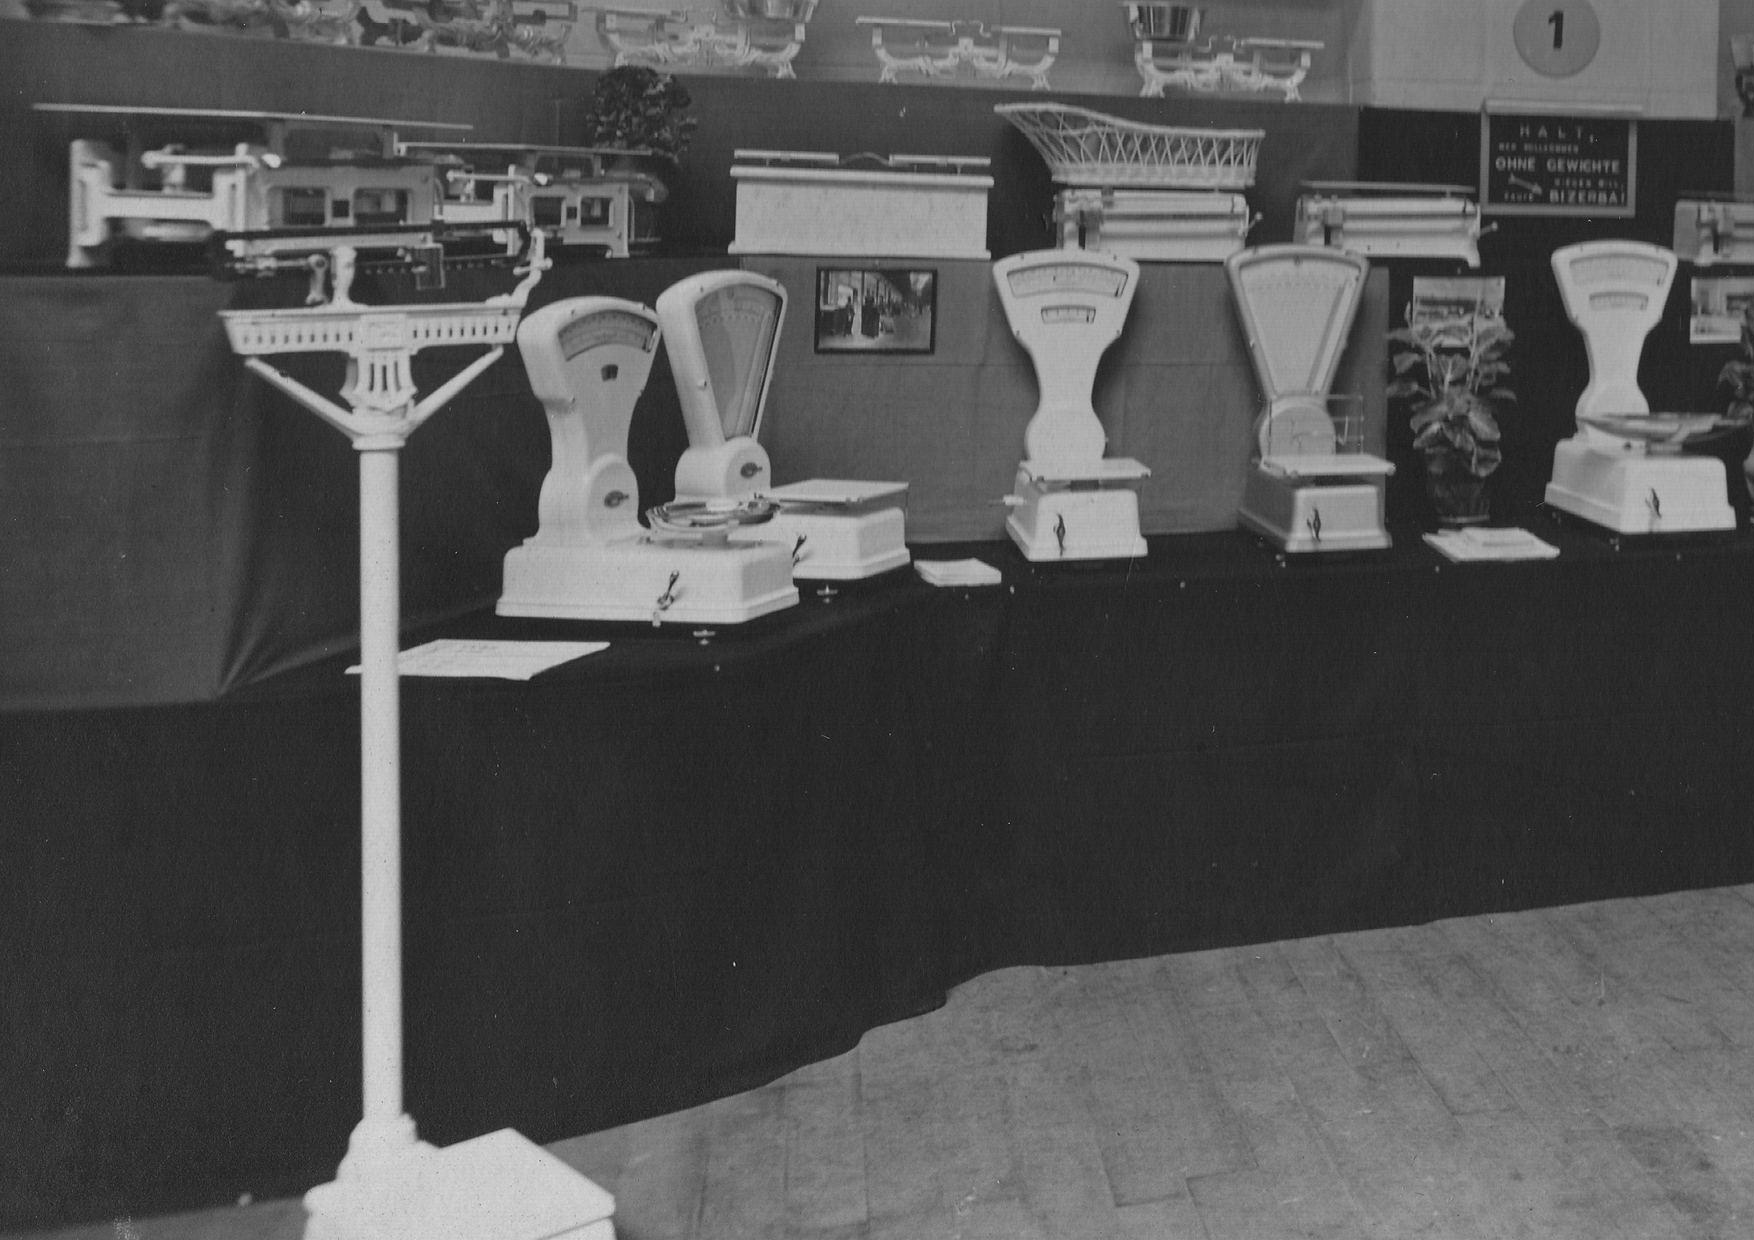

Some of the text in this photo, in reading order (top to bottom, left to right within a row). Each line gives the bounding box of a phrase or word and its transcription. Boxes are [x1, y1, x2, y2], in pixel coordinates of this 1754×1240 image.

[1548, 10, 1564, 50] 1
[1495, 155, 1621, 175] OHNE GEWICHTE
